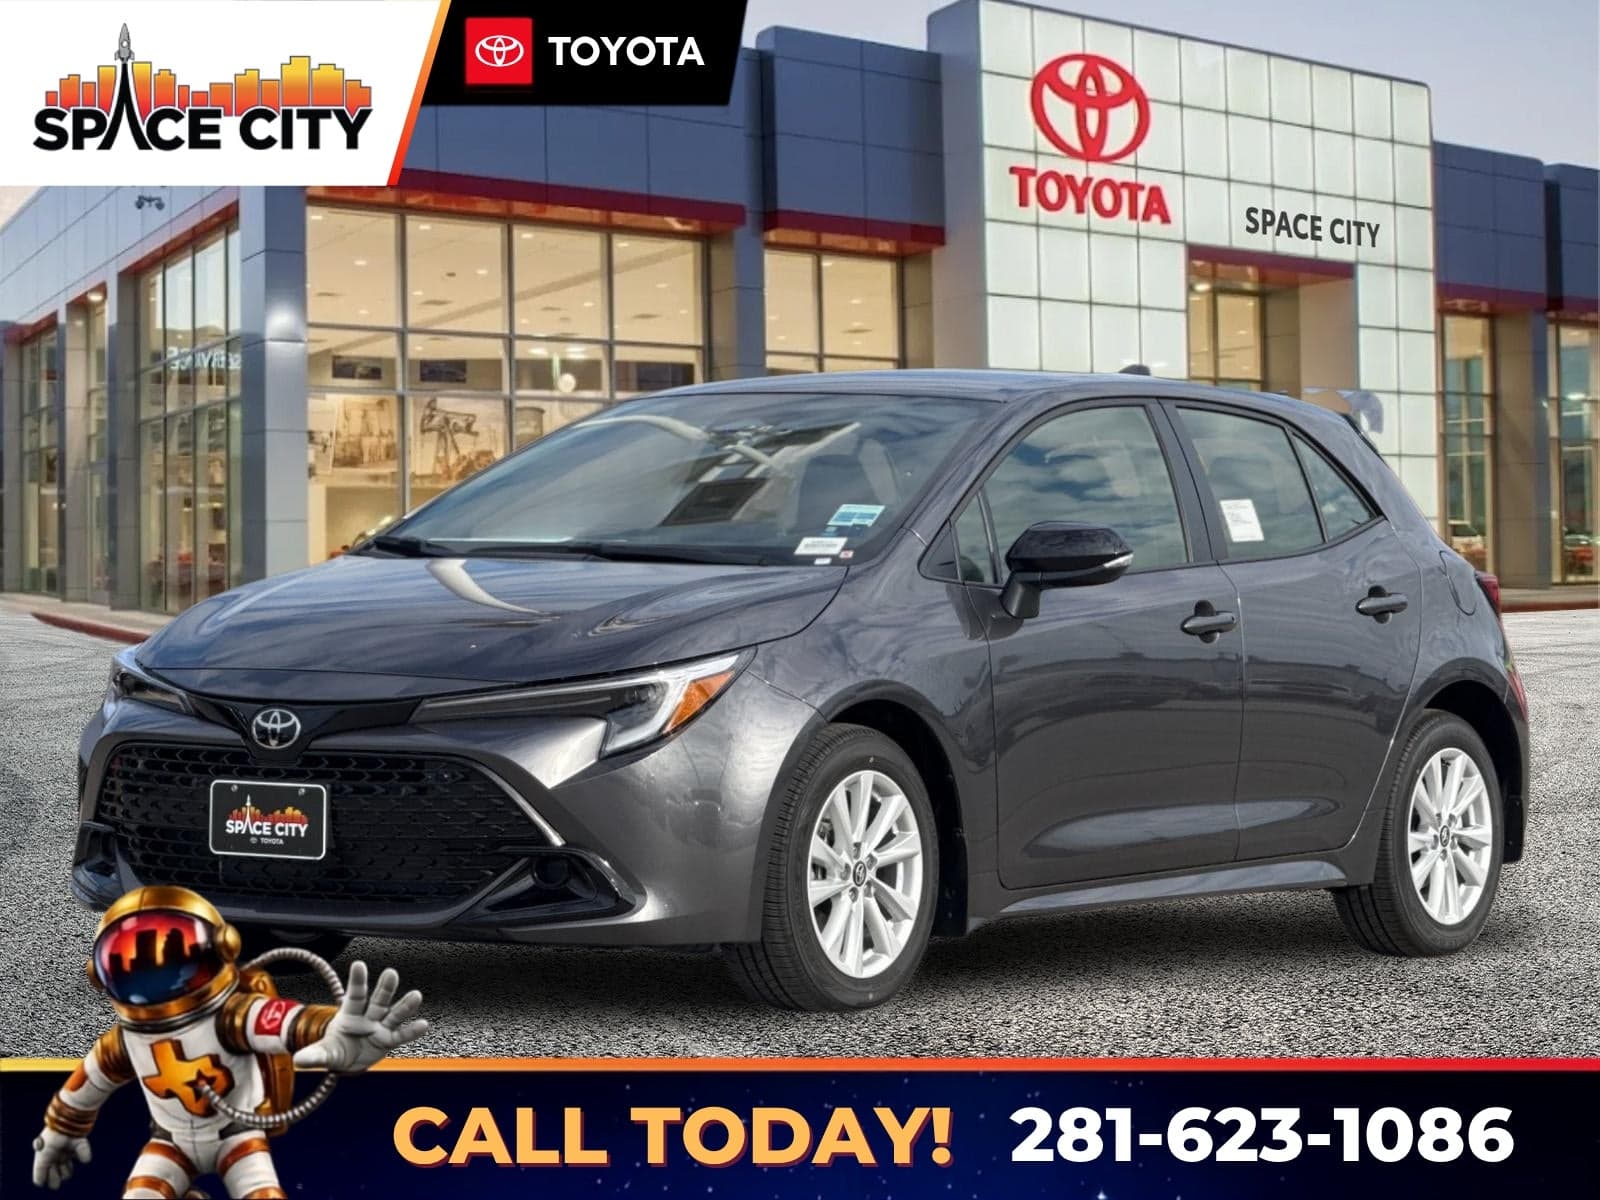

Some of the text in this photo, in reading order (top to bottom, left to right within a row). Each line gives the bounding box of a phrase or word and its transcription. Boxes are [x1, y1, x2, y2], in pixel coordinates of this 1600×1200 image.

[1009, 166, 1171, 224] TOYOTA
[1245, 206, 1380, 248] SPACE CITY
[225, 819, 309, 837] SPACE CITY
[259, 837, 285, 845] TOYOTA
